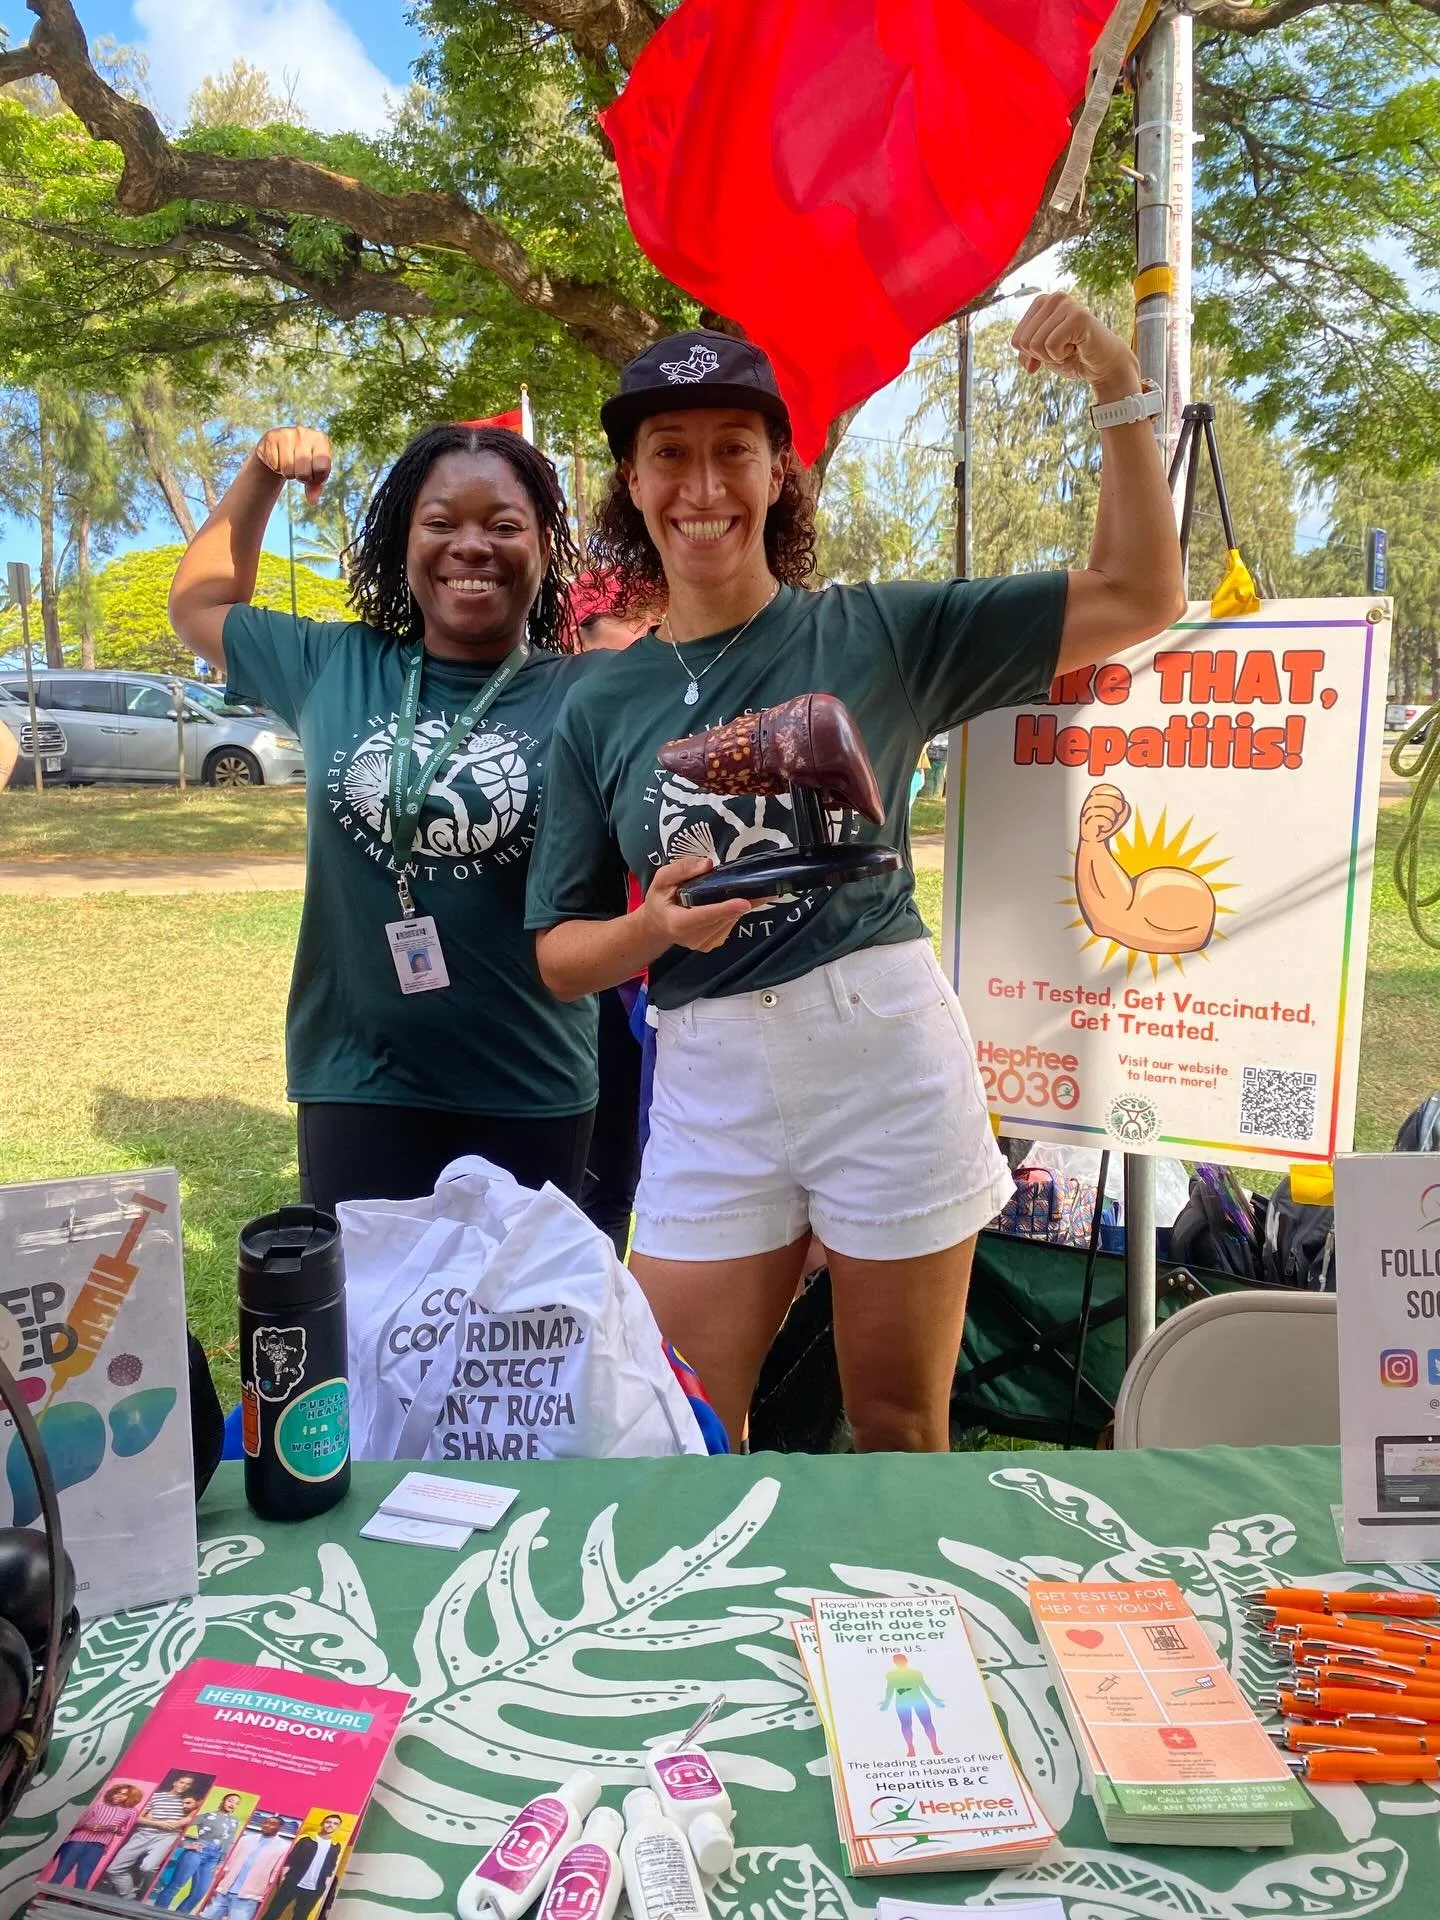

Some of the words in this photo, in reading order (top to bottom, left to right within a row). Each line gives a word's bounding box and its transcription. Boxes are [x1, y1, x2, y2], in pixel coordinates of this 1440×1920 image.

[1172, 81, 1185, 170] CHAROTTE
[1172, 184, 1184, 223] PIPE
[1153, 650, 1338, 709] THAT,
[473, 686, 496, 713] Department
[477, 719, 540, 751] STATE
[1014, 711, 1306, 776] Hepatitis!
[397, 752, 405, 786] Department
[415, 760, 436, 796] Department
[453, 859, 484, 881] OF
[988, 977, 1027, 1000] Get
[1032, 980, 1117, 1010] Tested,
[1123, 988, 1166, 1011] Get
[1173, 992, 1317, 1027] Vaccinated,
[1070, 1009, 1111, 1032] Get
[1117, 1013, 1220, 1043] Treated.
[977, 1039, 1079, 1073] HepFree
[1118, 1053, 1149, 1068] Visit
[1152, 1060, 1175, 1071] our
[1178, 1062, 1229, 1076] website
[979, 1066, 1081, 1110] 2030
[1127, 1069, 1140, 1081] to
[1143, 1070, 1177, 1085] learn
[1180, 1077, 1217, 1090] more!
[507, 1392, 576, 1427] RUSH
[442, 1431, 540, 1461] SHARE
[867, 1600, 888, 1608] has
[916, 1599, 929, 1607] of
[931, 1598, 951, 1607] the
[1036, 1591, 1068, 1601] GET
[1072, 1590, 1130, 1601] TESTED
[1135, 1588, 1168, 1600] FOR
[1040, 1604, 1073, 1615] HEP
[1078, 1604, 1092, 1615] C
[1095, 1603, 1109, 1615] IF
[1114, 1601, 1177, 1614] YOU'VE
[820, 1608, 885, 1622] highest
[890, 1608, 934, 1619] rates
[939, 1606, 958, 1617] of
[829, 1620, 883, 1632] death
[888, 1619, 923, 1630] due
[928, 1618, 947, 1628] to
[835, 1632, 873, 1644] liver
[879, 1630, 946, 1642] cancer
[867, 1645, 879, 1655] in
[881, 1645, 901, 1654] the
[904, 1644, 927, 1653] U.S.
[205, 1690, 364, 1728] HEALTHYSEXUAL
[214, 1708, 338, 1743] HANDBOOK
[848, 1761, 871, 1771] The
[873, 1758, 918, 1771] leading
[920, 1756, 961, 1766] causes
[963, 1754, 977, 1764] of
[978, 1752, 1004, 1763] liver
[865, 1770, 905, 1781] cancer
[908, 1768, 920, 1777] in
[969, 1764, 989, 1774] are
[875, 1778, 945, 1793] Hepatitis
[949, 1777, 960, 1788] B
[963, 1776, 975, 1787] &
[978, 1775, 990, 1785] C
[919, 1797, 1014, 1815] HepFree
